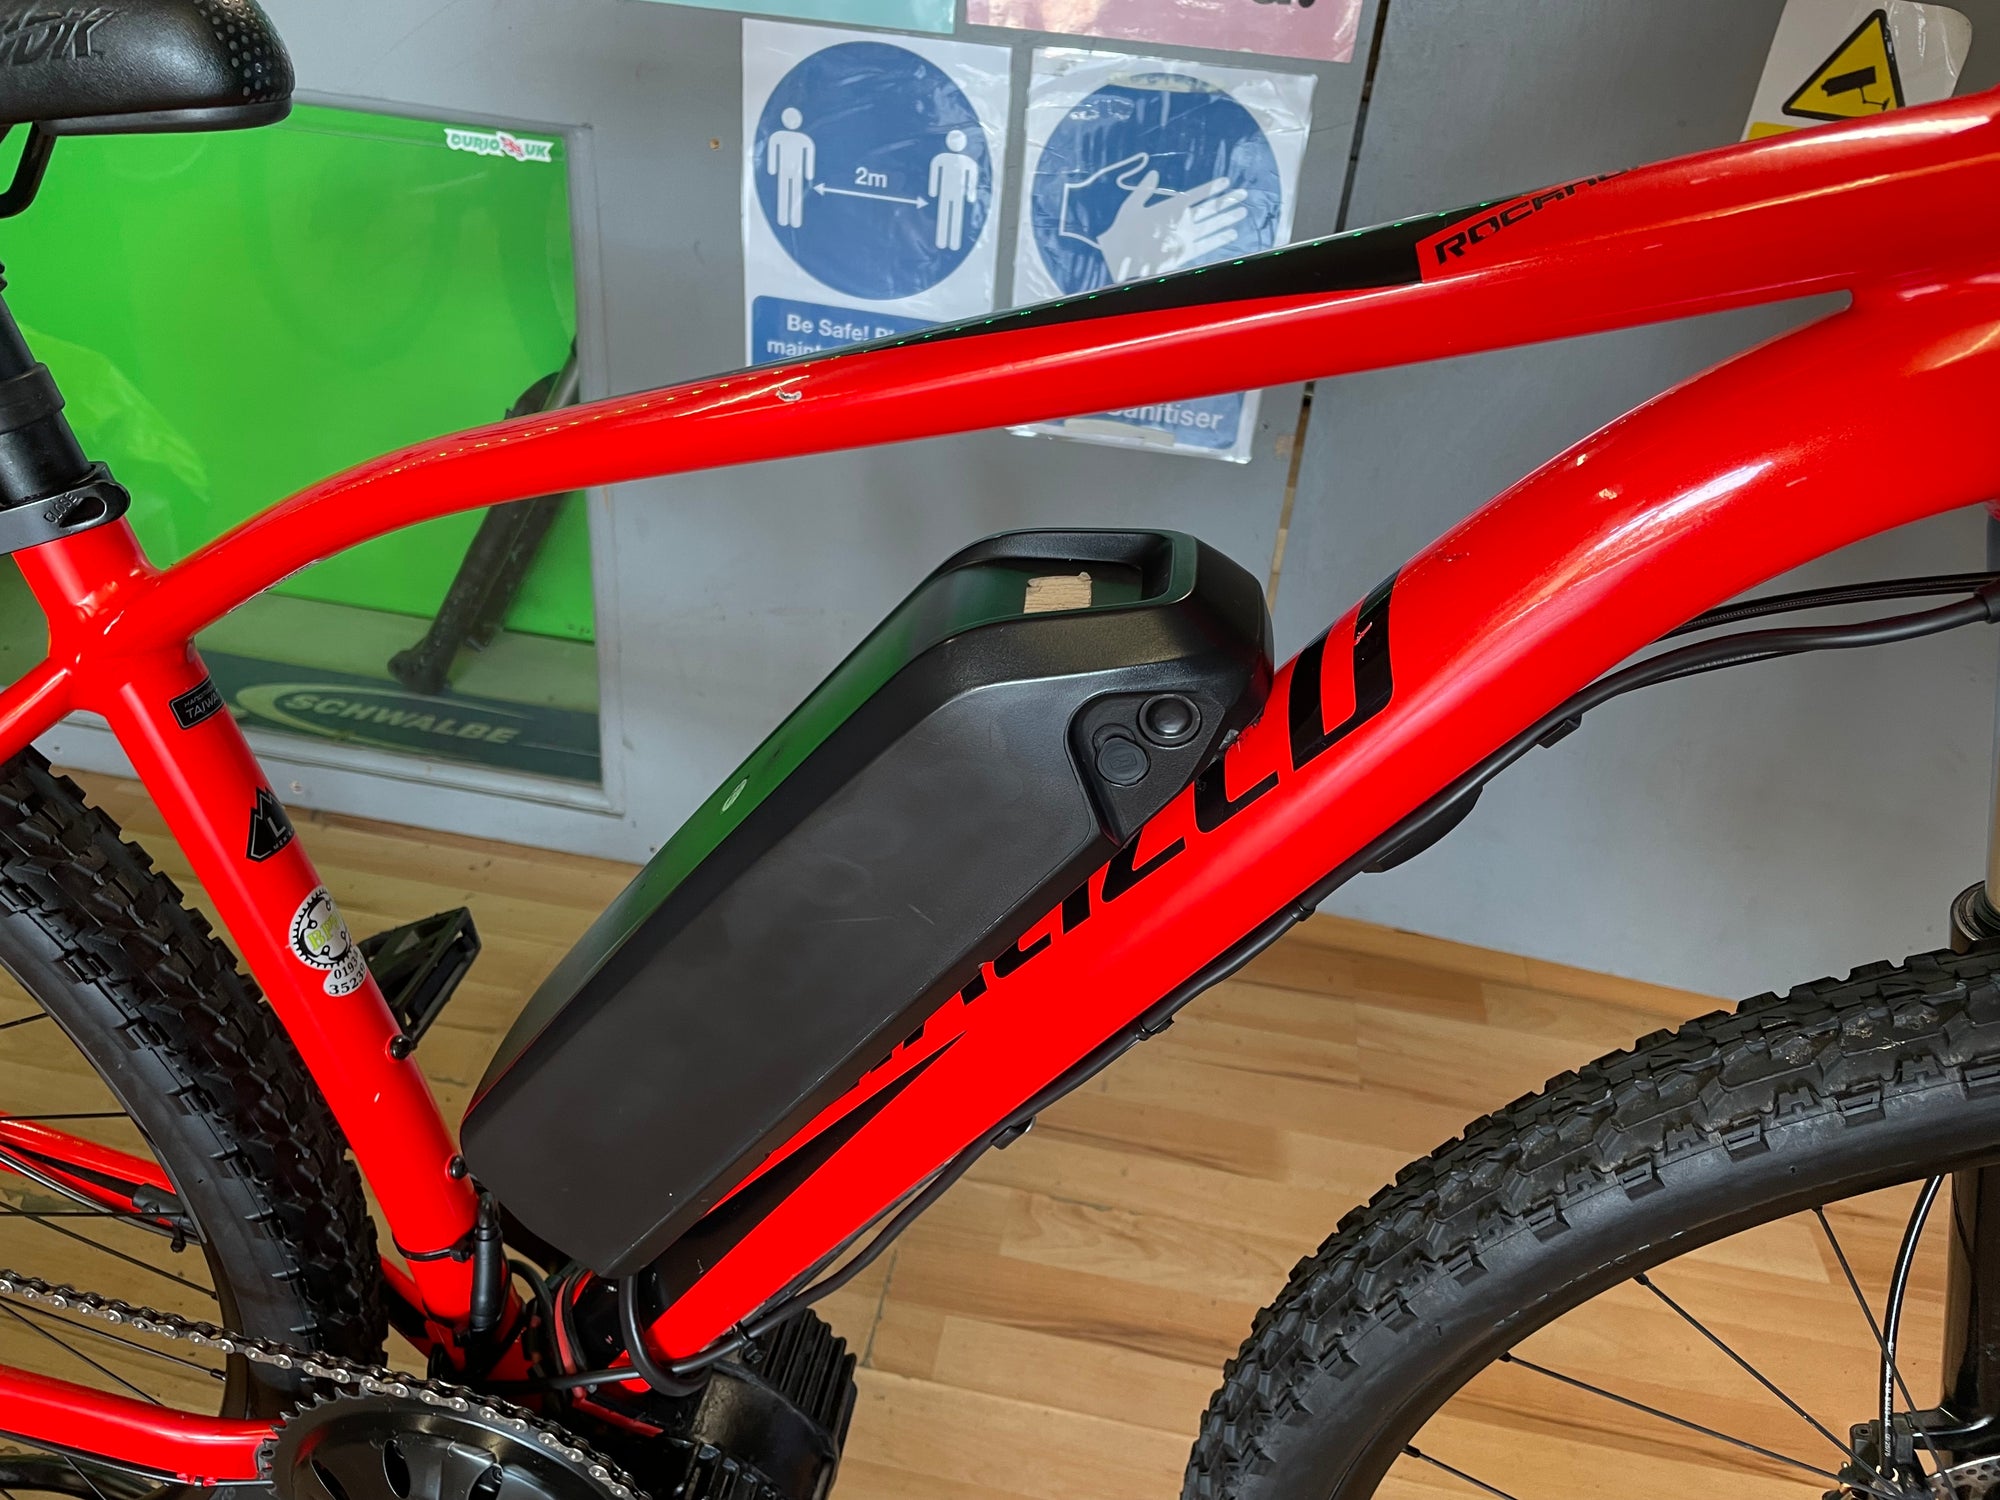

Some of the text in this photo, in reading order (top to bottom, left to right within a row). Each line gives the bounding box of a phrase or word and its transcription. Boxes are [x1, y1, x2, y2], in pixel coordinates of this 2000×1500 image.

[525, 143, 547, 158] UK
[854, 166, 888, 188] 2m
[786, 314, 814, 334] Be
[818, 319, 870, 341] Safe!
[1106, 402, 1224, 430] anitiser
[43, 491, 78, 524] CLOSE
[185, 692, 219, 719] TAIWA
[284, 695, 521, 744] SCHWALBE
[267, 816, 287, 838] L
